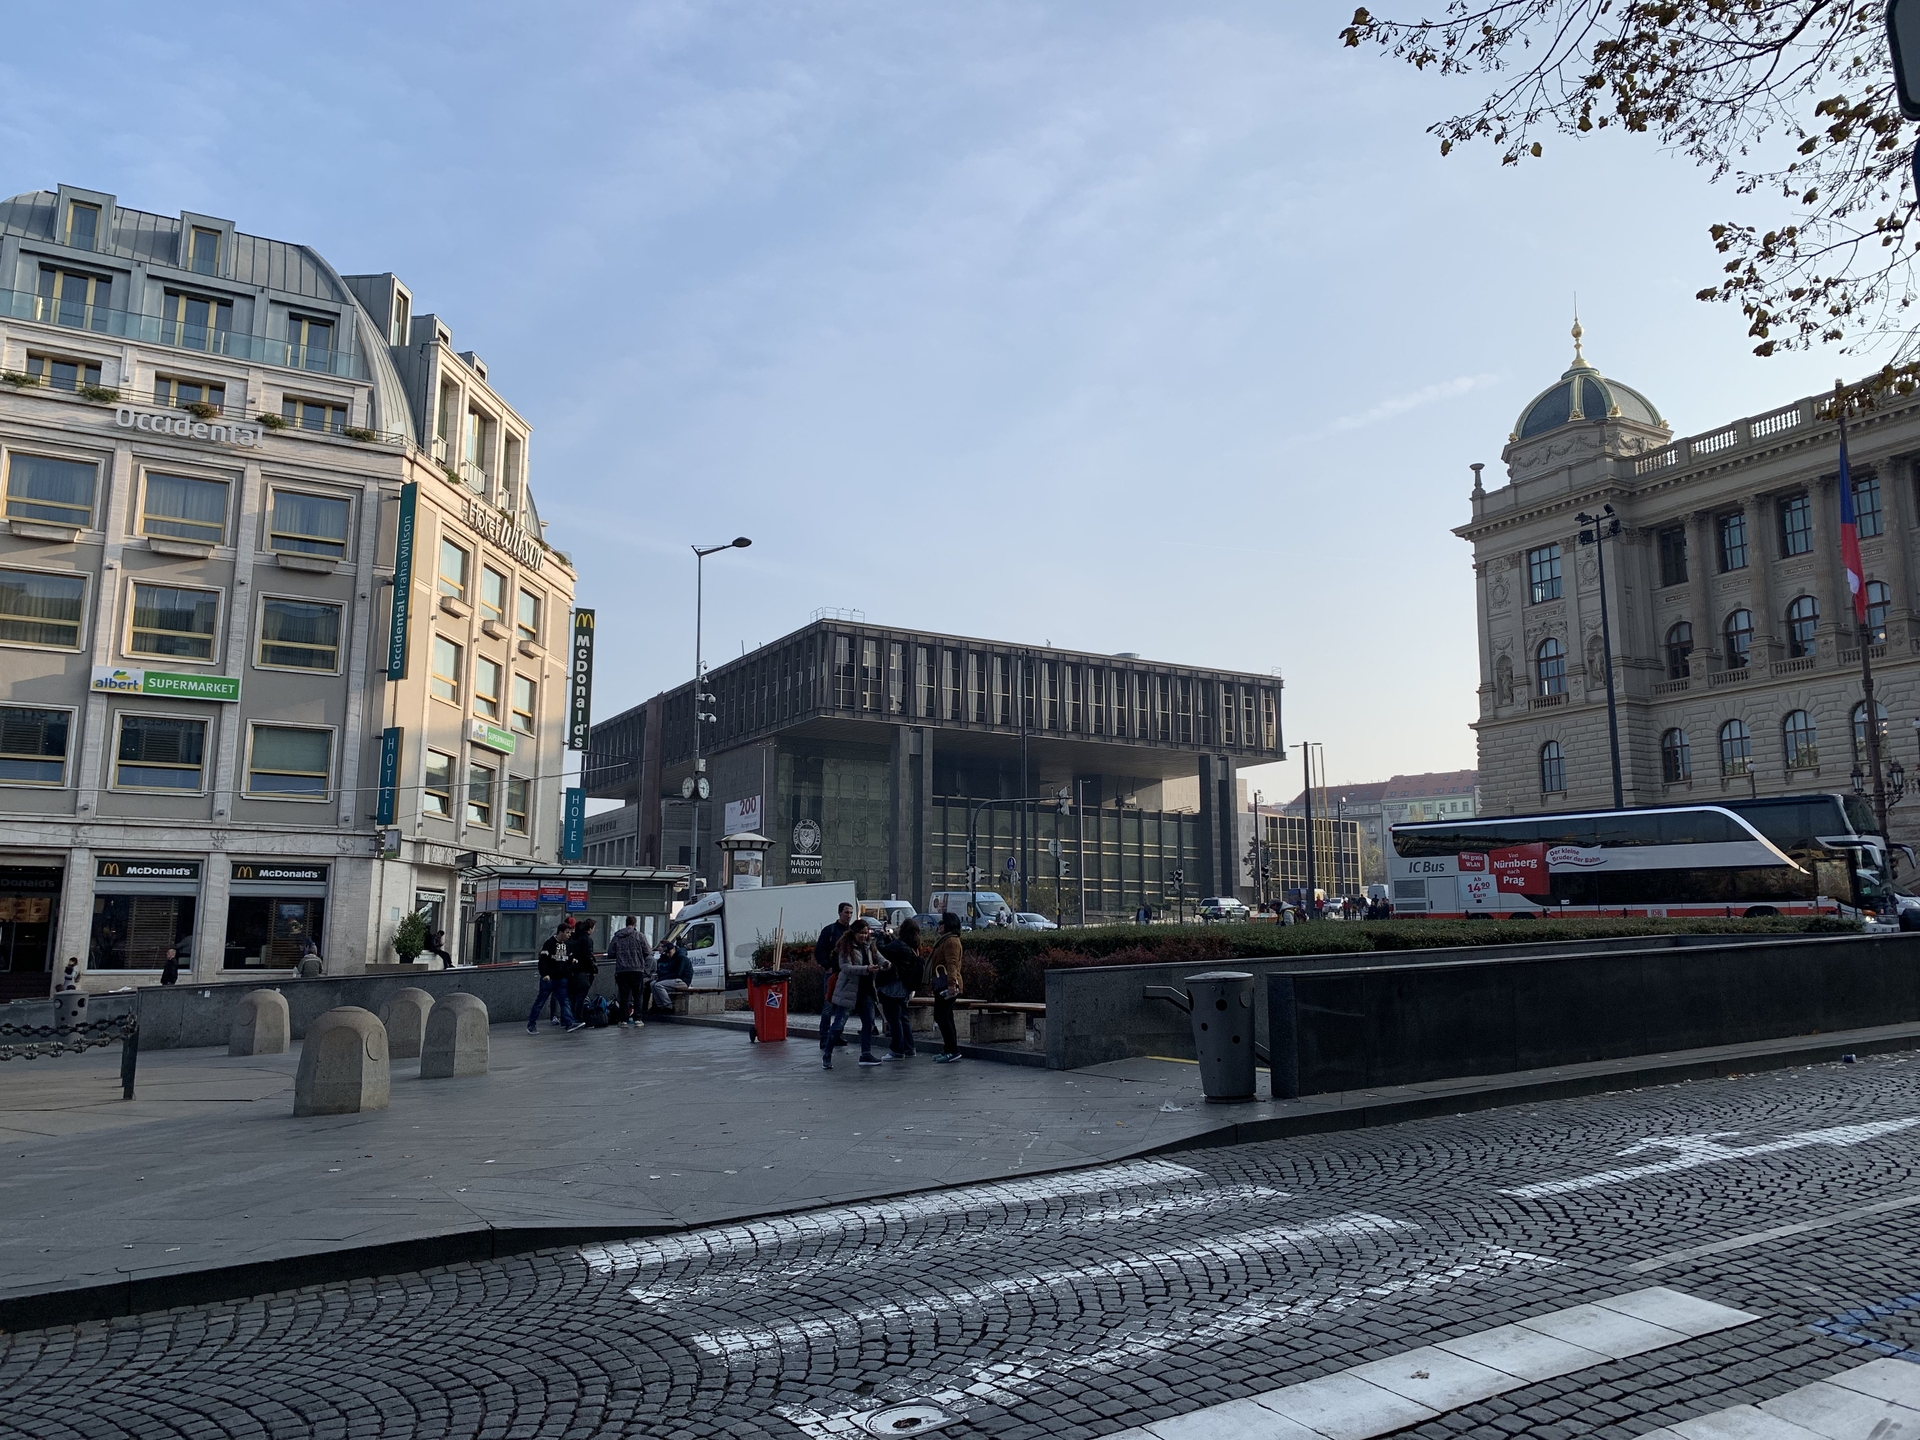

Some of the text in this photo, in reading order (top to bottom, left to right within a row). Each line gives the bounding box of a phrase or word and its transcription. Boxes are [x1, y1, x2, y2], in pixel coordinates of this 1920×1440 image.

[115, 406, 263, 448] Occidental
[392, 515, 412, 670] Occidental Praha Wilson
[95, 677, 235, 694] albert SUPERMARKET
[573, 634, 591, 748] McDonald's
[383, 737, 395, 815] HOTEL
[739, 796, 757, 816] 200
[570, 794, 580, 853] HOTEL
[1549, 847, 1580, 857] Der kleine
[790, 858, 823, 867] NÁRODNÍ
[1493, 858, 1538, 869] Nürnberg
[1551, 854, 1601, 863] Bruder der Bahn
[126, 866, 191, 876] McDonald's
[791, 867, 822, 875] MUZEUM
[1408, 861, 1445, 874] IC Bus
[258, 869, 318, 879] McDonald's
[1503, 875, 1525, 886] Prag
